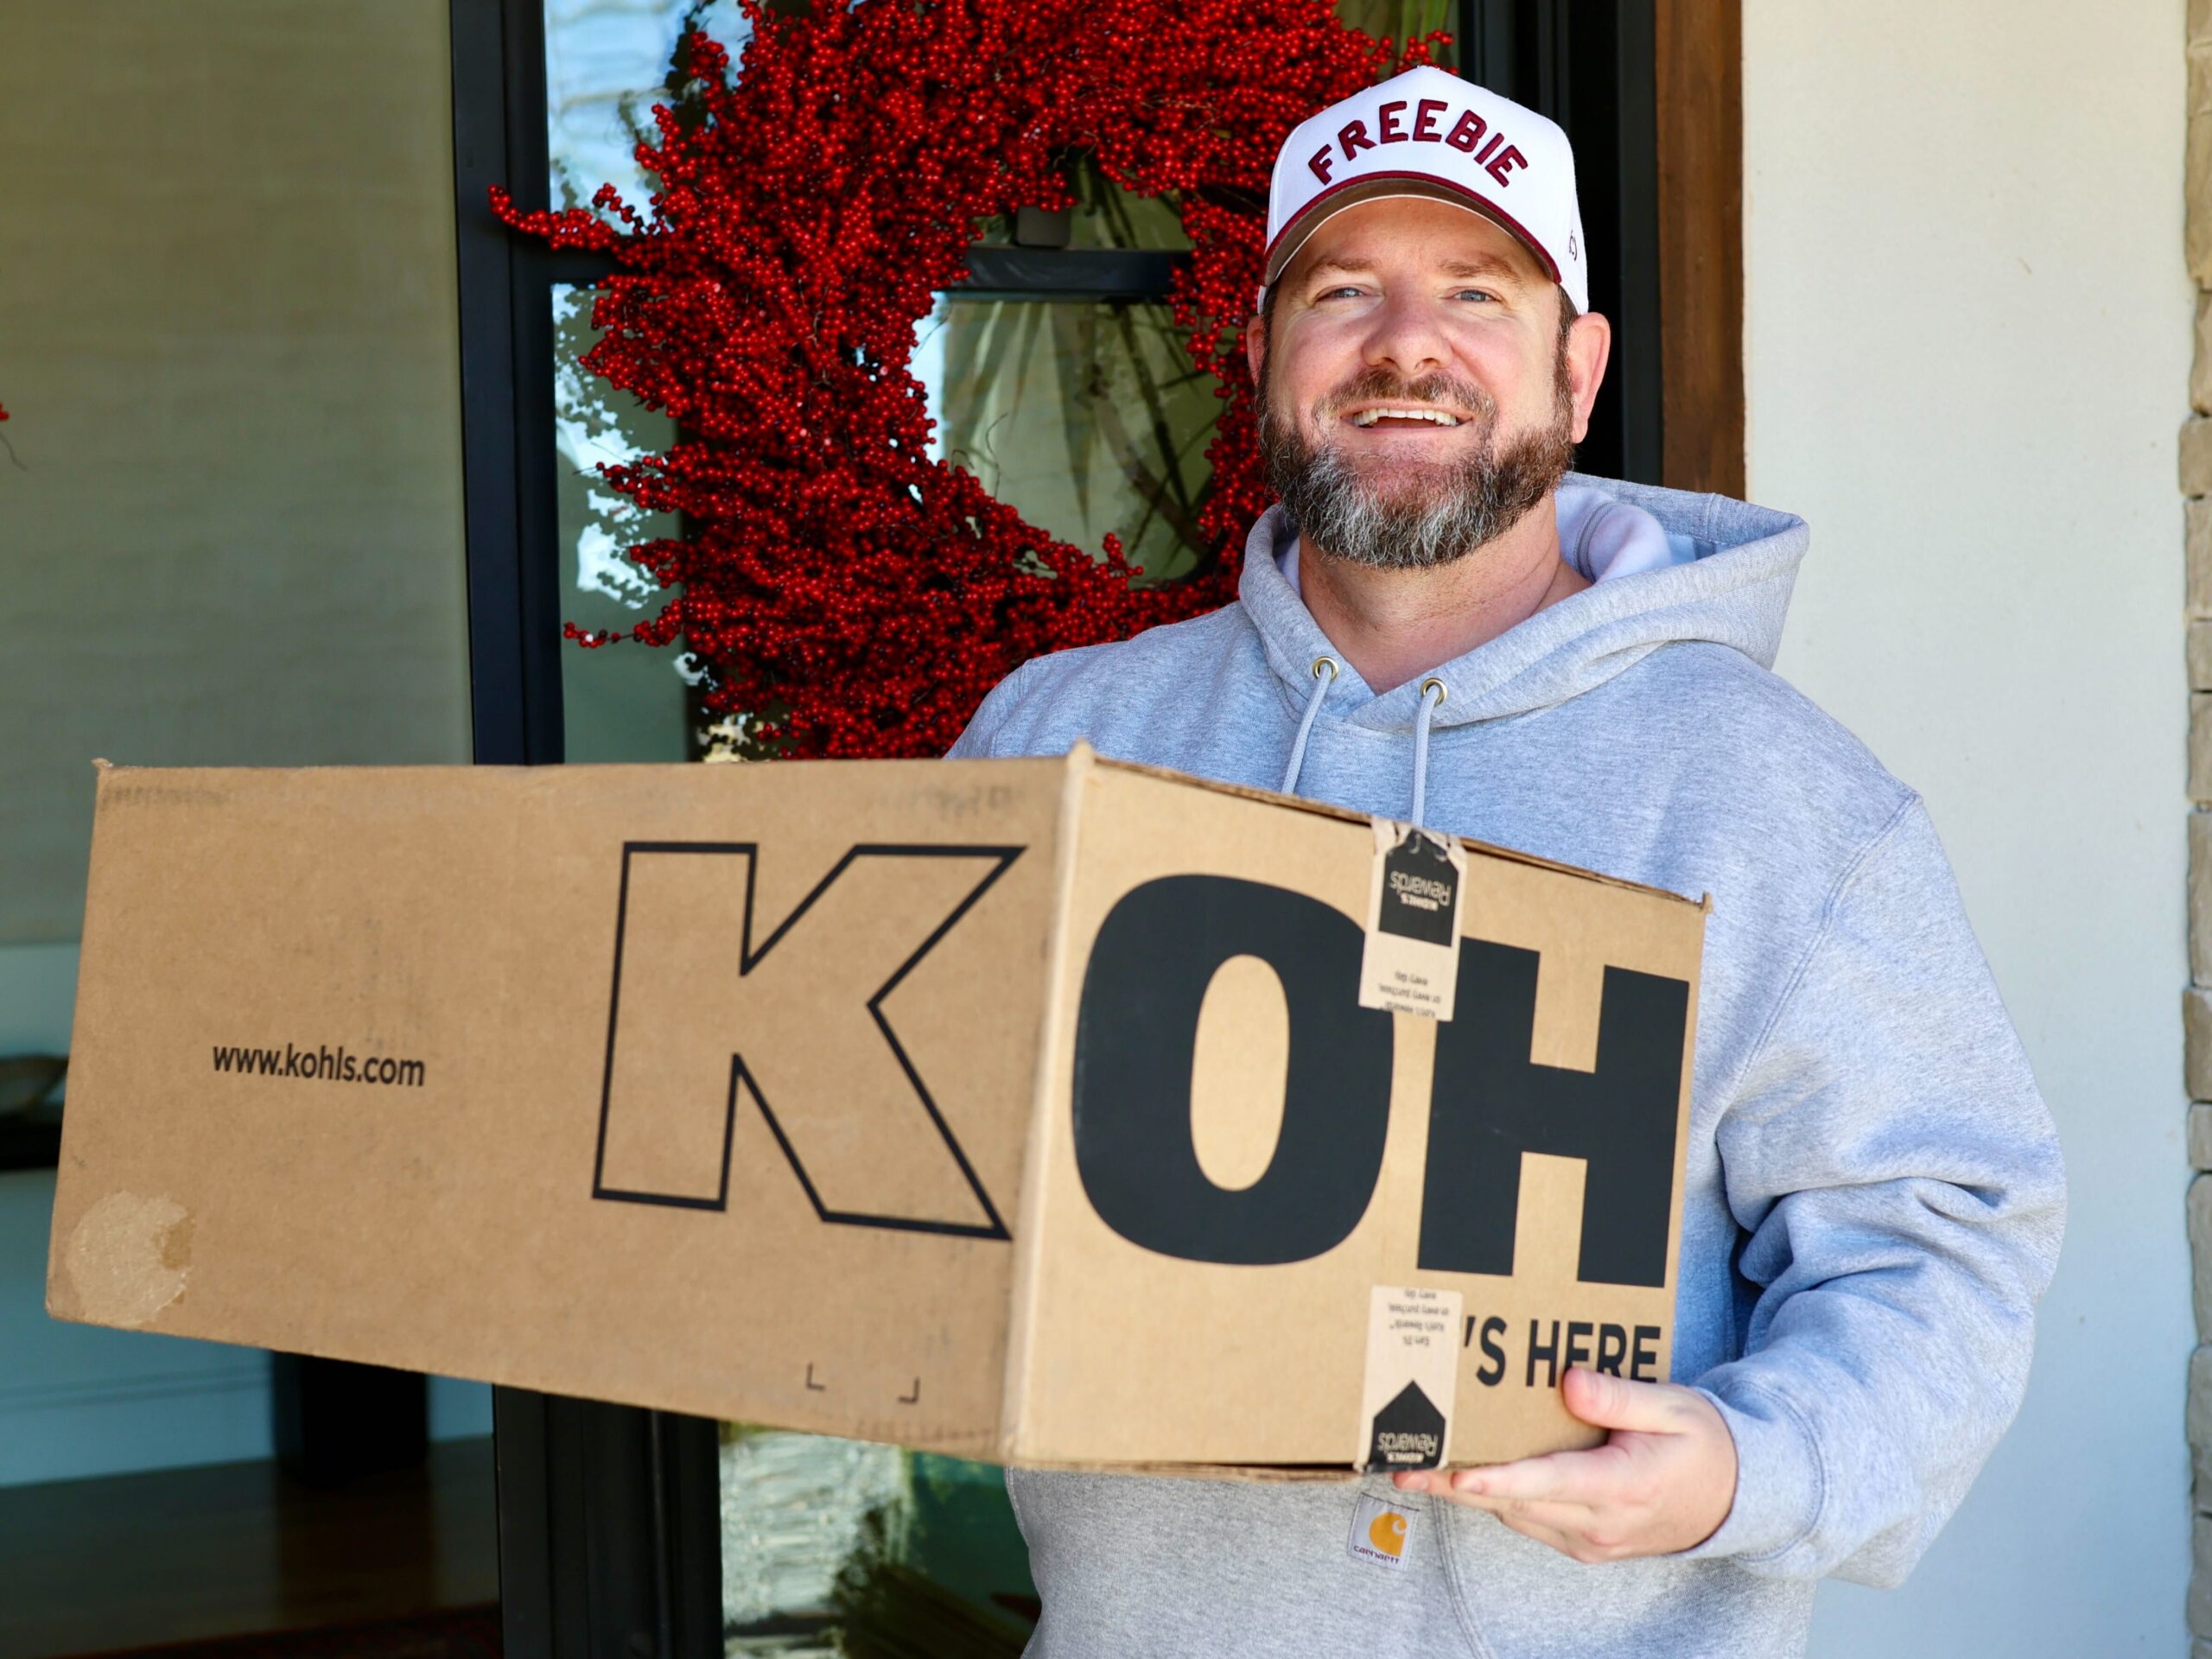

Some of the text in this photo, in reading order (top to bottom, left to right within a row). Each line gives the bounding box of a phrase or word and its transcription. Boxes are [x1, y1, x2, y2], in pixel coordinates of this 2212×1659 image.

[1307, 99, 1529, 188] FREEBIE
[1389, 871, 1452, 906] Rewards
[213, 1042, 425, 1087] www.kohls.com
[1526, 1319, 1662, 1389] HERE
[1377, 1433, 1438, 1457] Rewards
